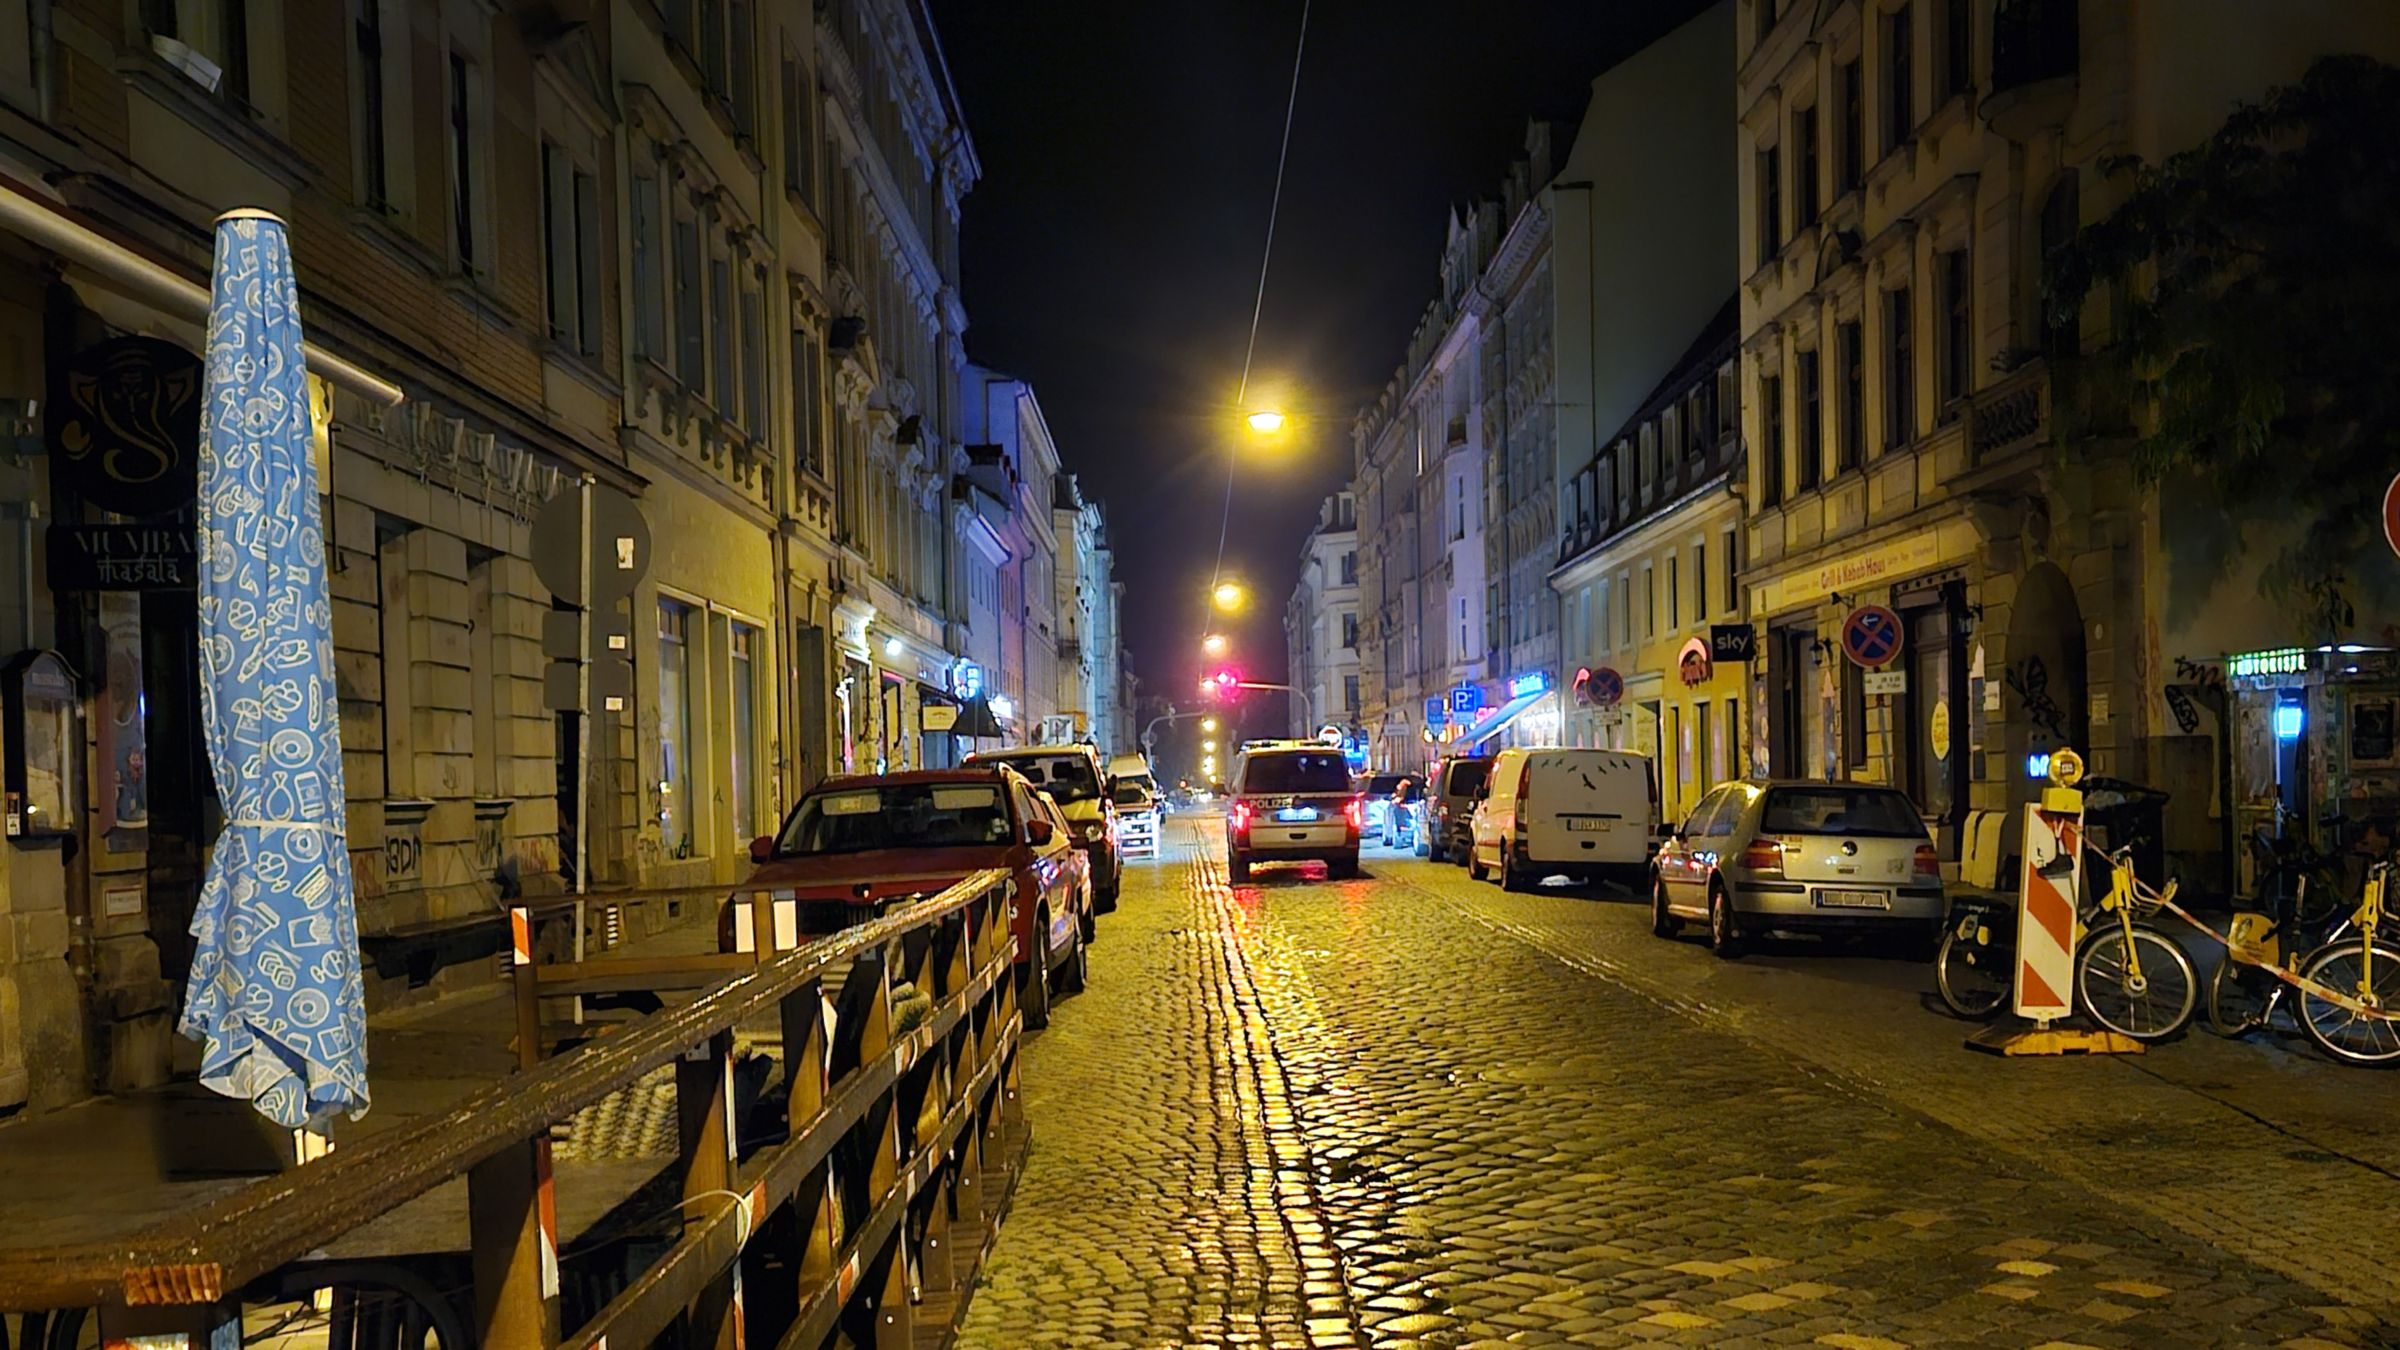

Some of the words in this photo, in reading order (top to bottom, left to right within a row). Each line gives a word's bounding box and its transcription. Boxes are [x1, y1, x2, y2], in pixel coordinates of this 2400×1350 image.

[74, 531, 194, 554] MUMBA
[96, 554, 181, 583] masala
[1716, 632, 1748, 653] sky
[1455, 691, 1468, 709] P
